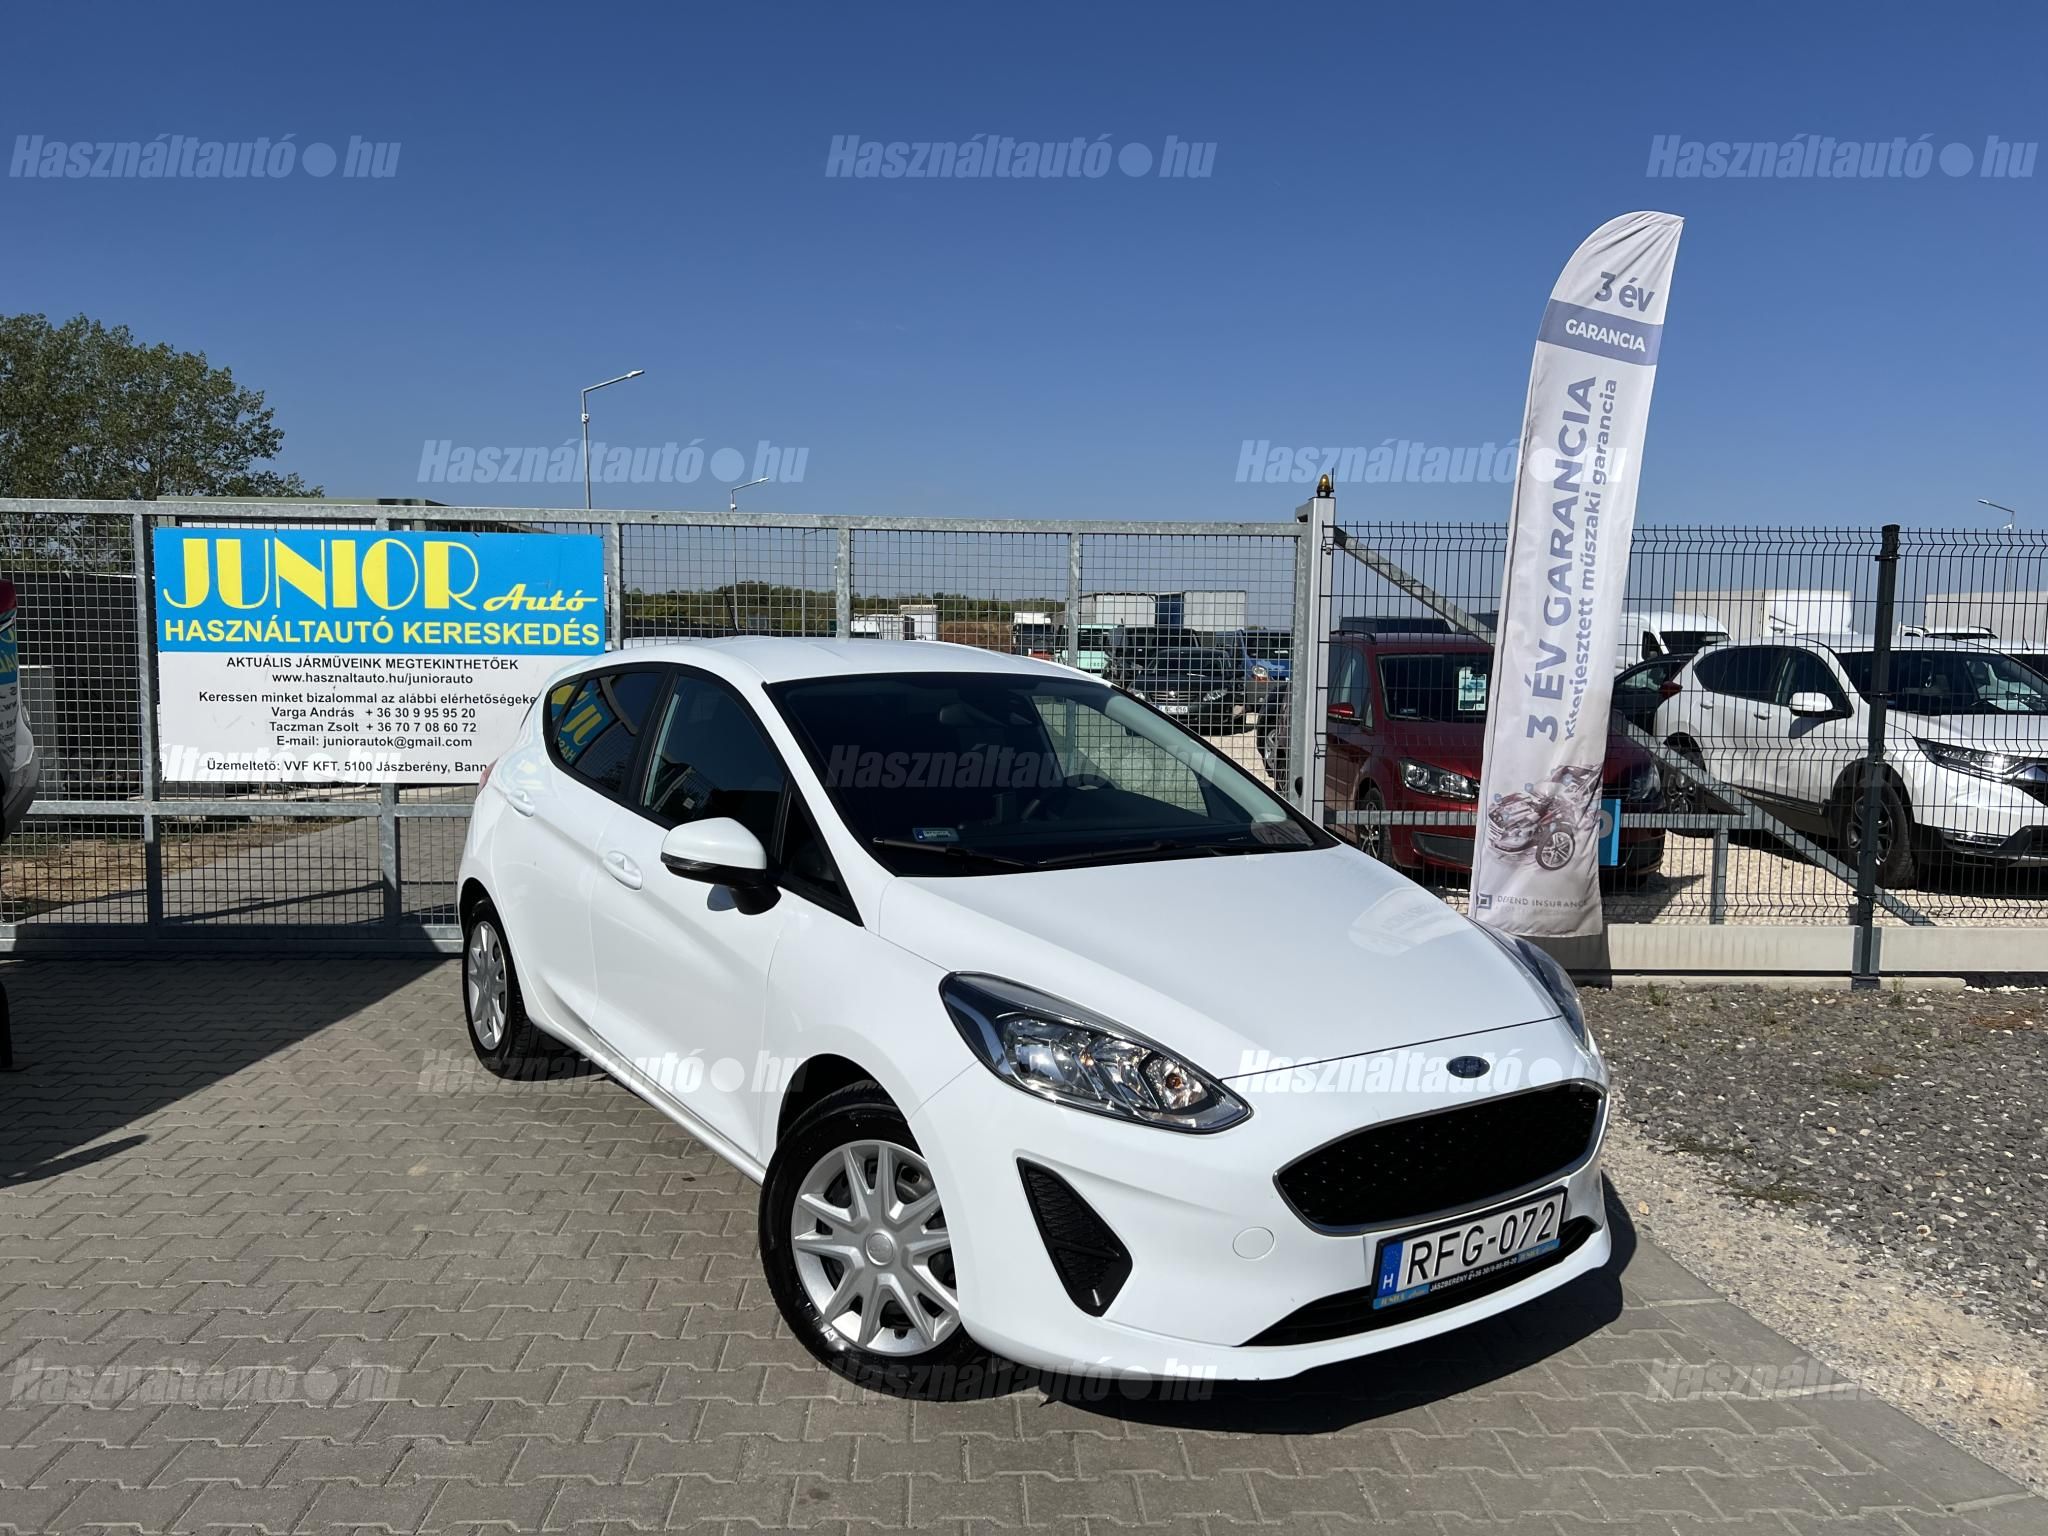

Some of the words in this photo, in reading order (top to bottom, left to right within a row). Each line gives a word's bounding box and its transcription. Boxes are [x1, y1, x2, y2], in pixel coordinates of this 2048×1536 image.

[1594, 271, 1616, 303] 3
[1618, 277, 1655, 312] év
[1565, 318, 1646, 352] GARANCIA
[1544, 376, 1597, 627] GARANCIA
[1565, 596, 1594, 741] Kiterjesztett
[1581, 491, 1602, 591] műszaki
[1592, 378, 1617, 486] garancia
[163, 537, 479, 611] JUNIOR
[482, 583, 598, 612] Autó
[165, 614, 394, 644] HASZNÁLTAUTÓ
[403, 617, 600, 646] KERESKEDÉS
[227, 655, 292, 668] AKTUÁLIS
[295, 655, 382, 669] JÁRMŰVEINK
[385, 656, 519, 670] MEGTEKINTHETŐEK
[1524, 639, 1569, 701] ÉV
[272, 672, 473, 685] www.hasznaltauto.hu/juniorauto
[199, 691, 257, 702] Keressen
[261, 692, 303, 703] minket
[307, 692, 377, 704] bizalommal
[381, 695, 395, 704] az
[398, 693, 437, 704] alábbi
[269, 721, 324, 732] Taczman
[327, 721, 359, 732] Zsolt
[377, 722, 392, 733] 36
[395, 722, 410, 733] 70
[414, 722, 421, 733] 7
[425, 722, 440, 733] 08
[443, 722, 458, 733] 60
[462, 722, 477, 733] 72
[271, 706, 307, 720] Varga
[310, 706, 355, 717] András
[376, 707, 391, 718] 36
[395, 707, 409, 718] 30
[413, 707, 420, 718] 9
[424, 707, 439, 718] 95
[442, 707, 457, 718] 95
[461, 707, 476, 718] 20
[276, 735, 319, 746] E-mail:
[322, 736, 473, 749] juniorautok@gmail.com
[1526, 714, 1559, 742] 3
[207, 757, 280, 771] Üzemeltető:
[284, 760, 309, 771] VVF
[313, 761, 340, 772] KFT.
[344, 761, 373, 772] 5100
[376, 761, 450, 774] Jászberény,
[1406, 1202, 1556, 1285] RFG-072
[1382, 1273, 1394, 1290] H
